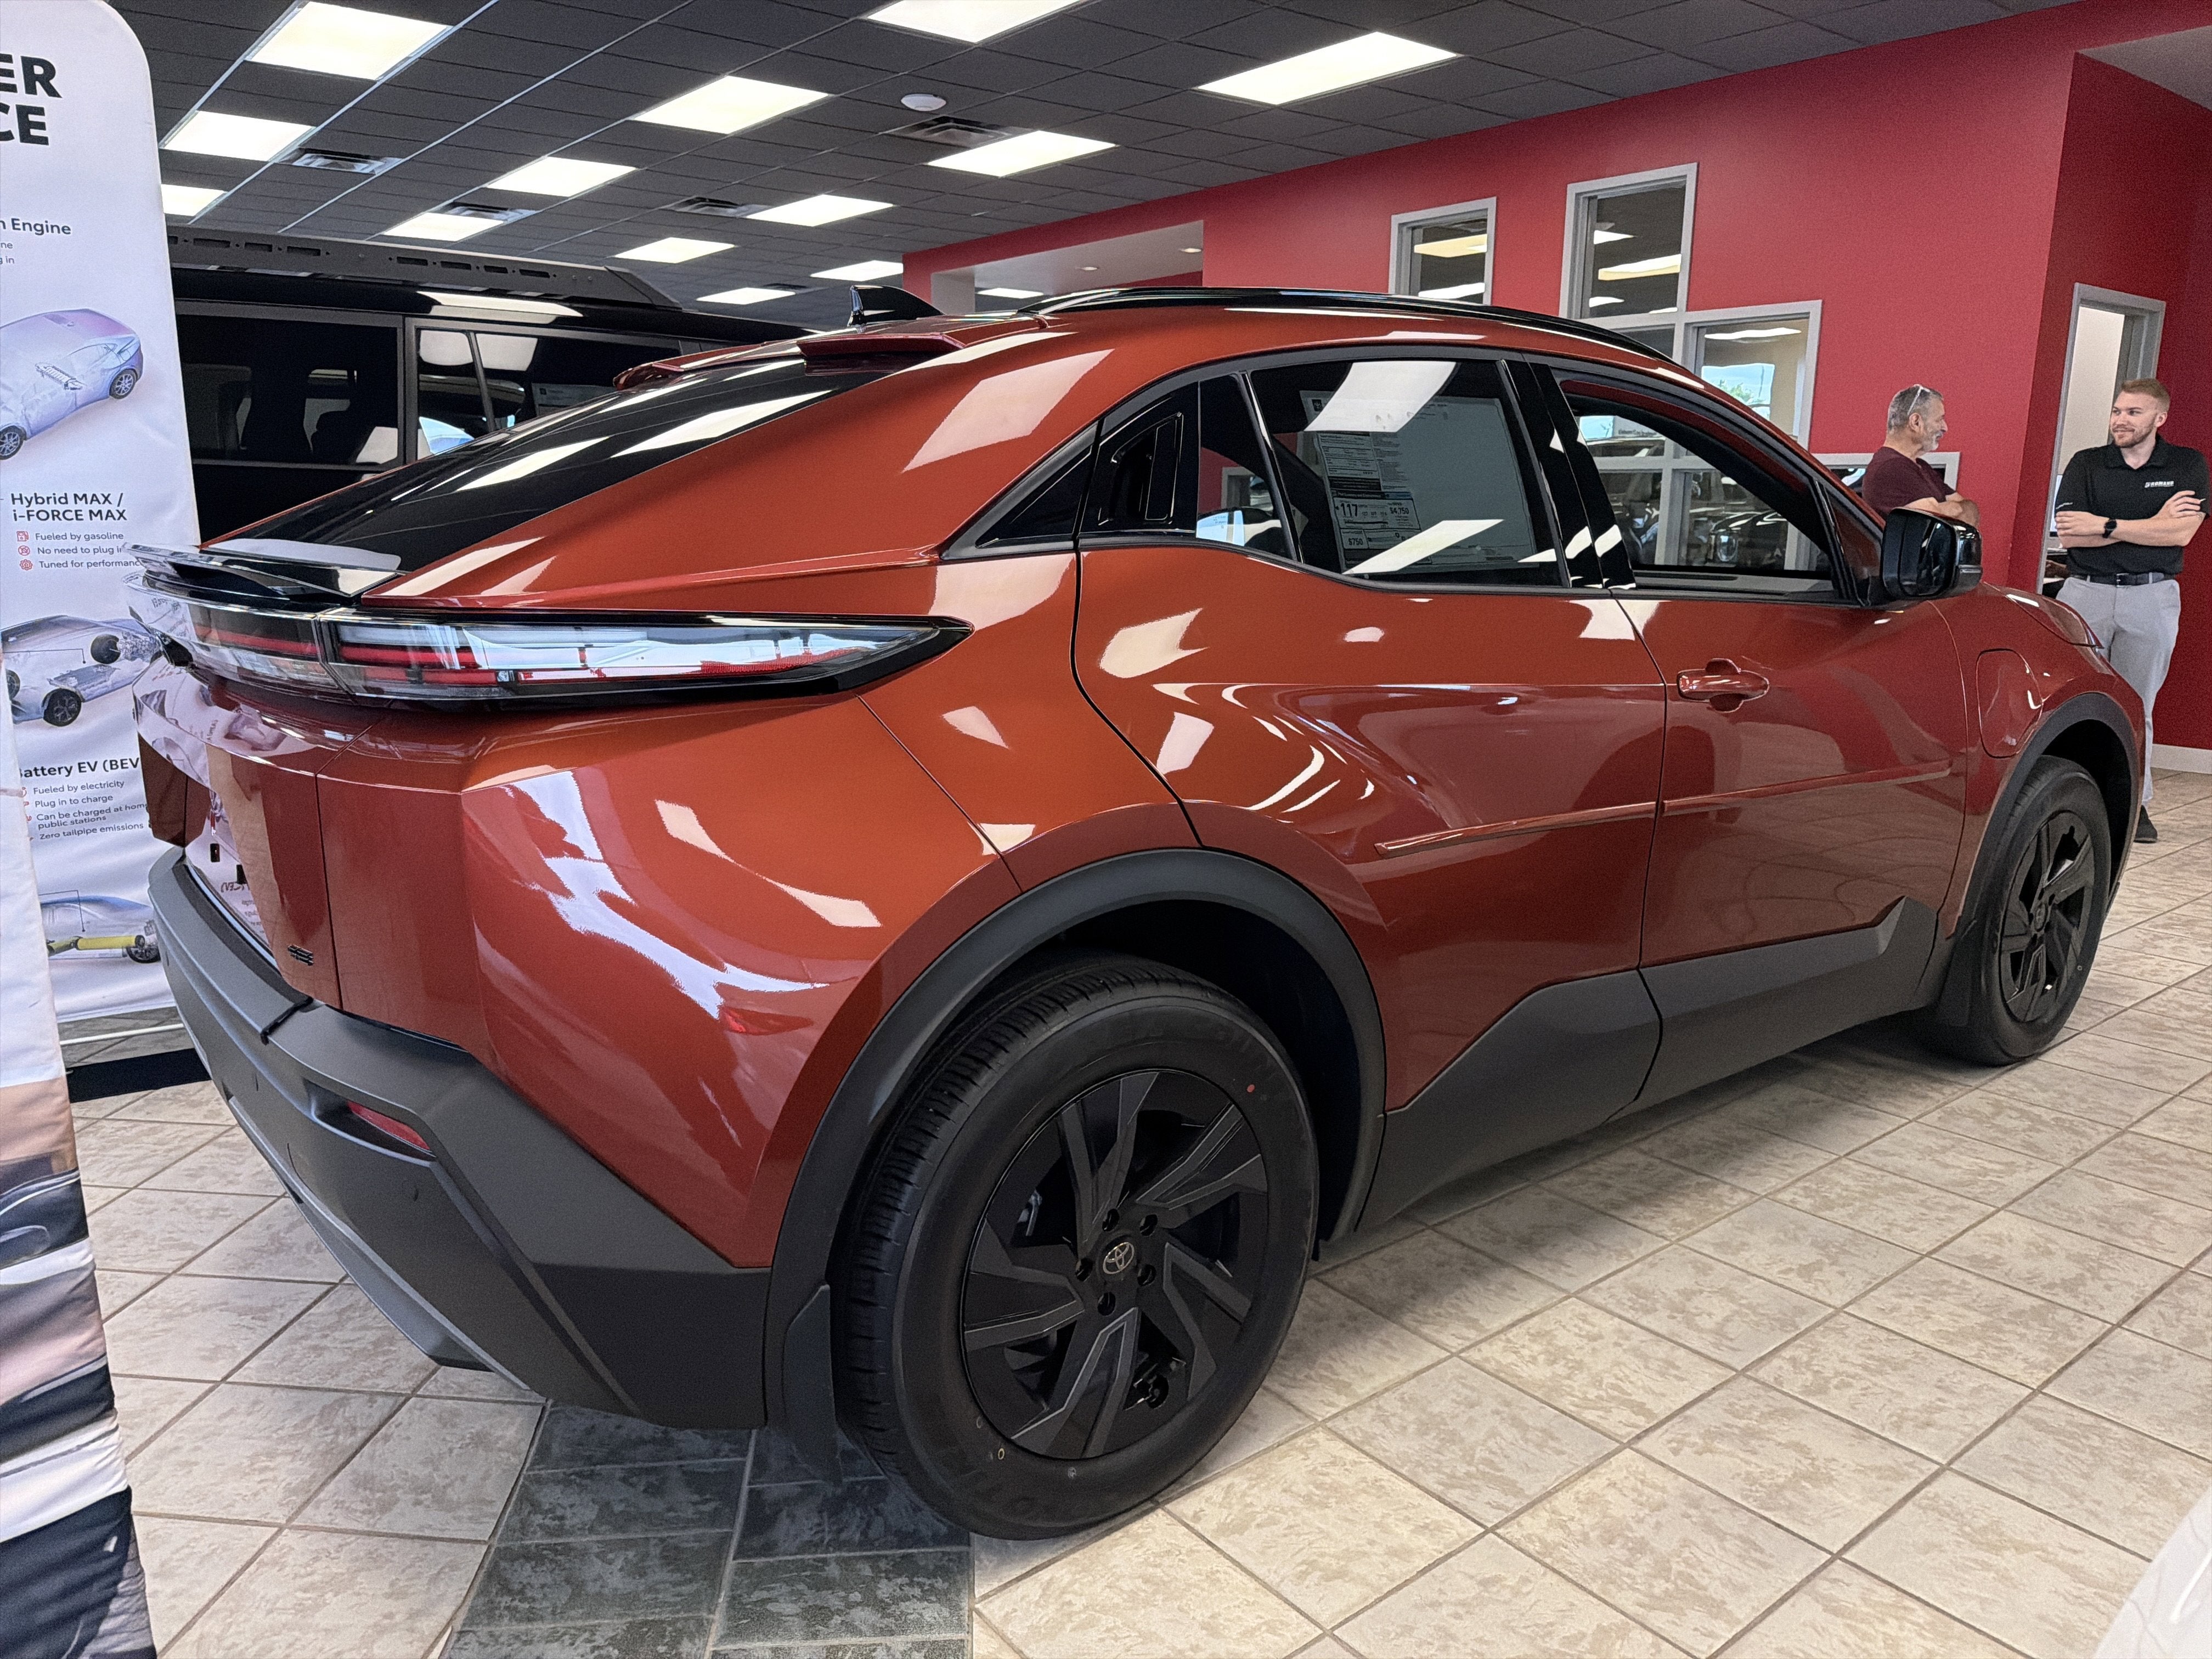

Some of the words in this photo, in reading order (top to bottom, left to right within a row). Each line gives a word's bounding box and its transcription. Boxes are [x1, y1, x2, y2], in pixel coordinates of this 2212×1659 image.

[11, 218, 71, 235] Engine
[11, 493, 69, 507] Hybrid
[74, 493, 113, 505] MAX
[117, 493, 123, 507] /
[13, 509, 84, 521] i-FORCE
[88, 509, 127, 521] MAX
[1341, 503, 1358, 517] 117
[35, 532, 67, 540] Fueled
[70, 533, 81, 541] by
[84, 532, 124, 541] gasoline
[93, 546, 114, 555] plug
[70, 560, 83, 568] for
[19, 765, 72, 778] attery
[78, 761, 98, 773] EV
[33, 784, 65, 794] Fueled
[67, 785, 78, 793] by
[80, 780, 125, 791] electricity
[35, 799, 56, 808] Plug
[81, 794, 114, 804] charge
[36, 813, 56, 821] Can
[58, 811, 71, 819] be
[72, 807, 111, 817] charged
[38, 819, 69, 831] public
[70, 815, 106, 825] stations
[63, 826, 98, 837] tailpipe
[99, 822, 144, 833] emissions
